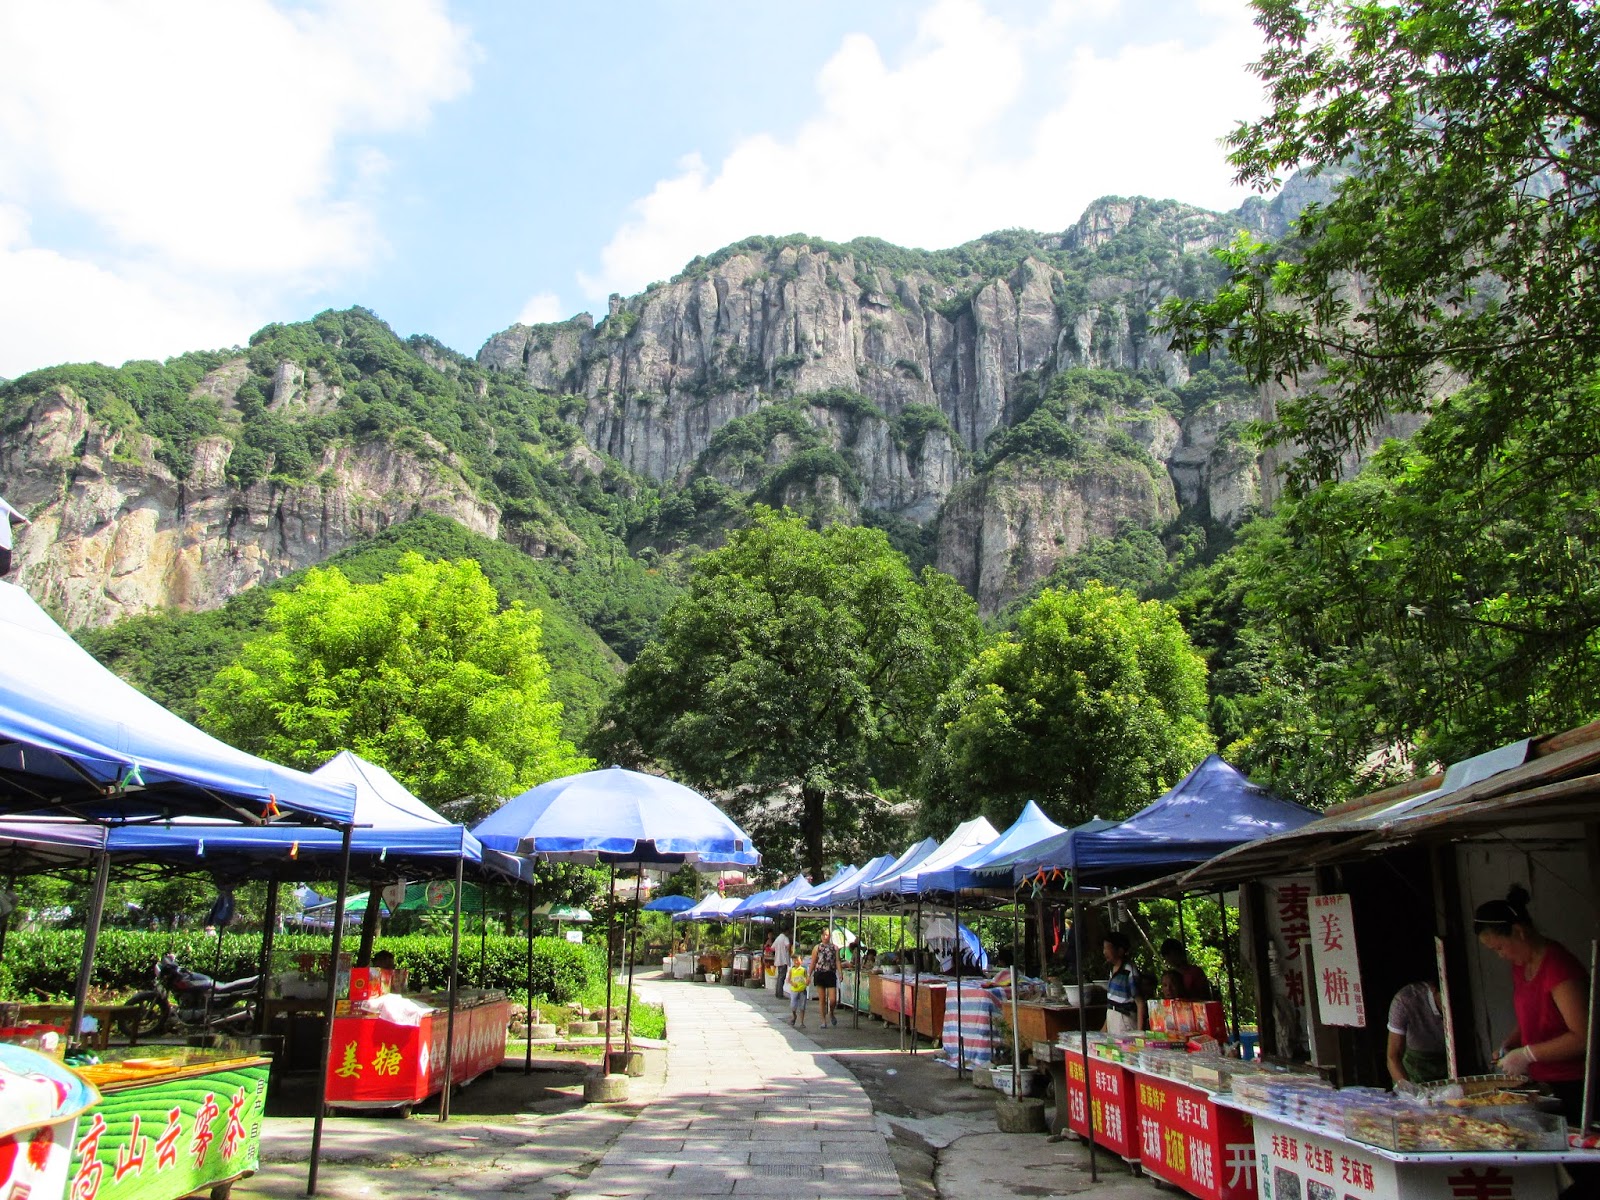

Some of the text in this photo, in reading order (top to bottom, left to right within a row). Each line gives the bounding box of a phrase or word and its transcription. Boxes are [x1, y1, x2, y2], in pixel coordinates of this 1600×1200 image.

[1317, 913, 1350, 1007] 姜糖
[335, 1040, 403, 1079] 姜糖
[1176, 1096, 1209, 1130] 纯手工做
[71, 1086, 246, 1200] 高山云雾茶
[1164, 1125, 1186, 1176] 龙须酥
[1271, 1132, 1375, 1193] 夫妻酥 花生酥 芝麻酥
